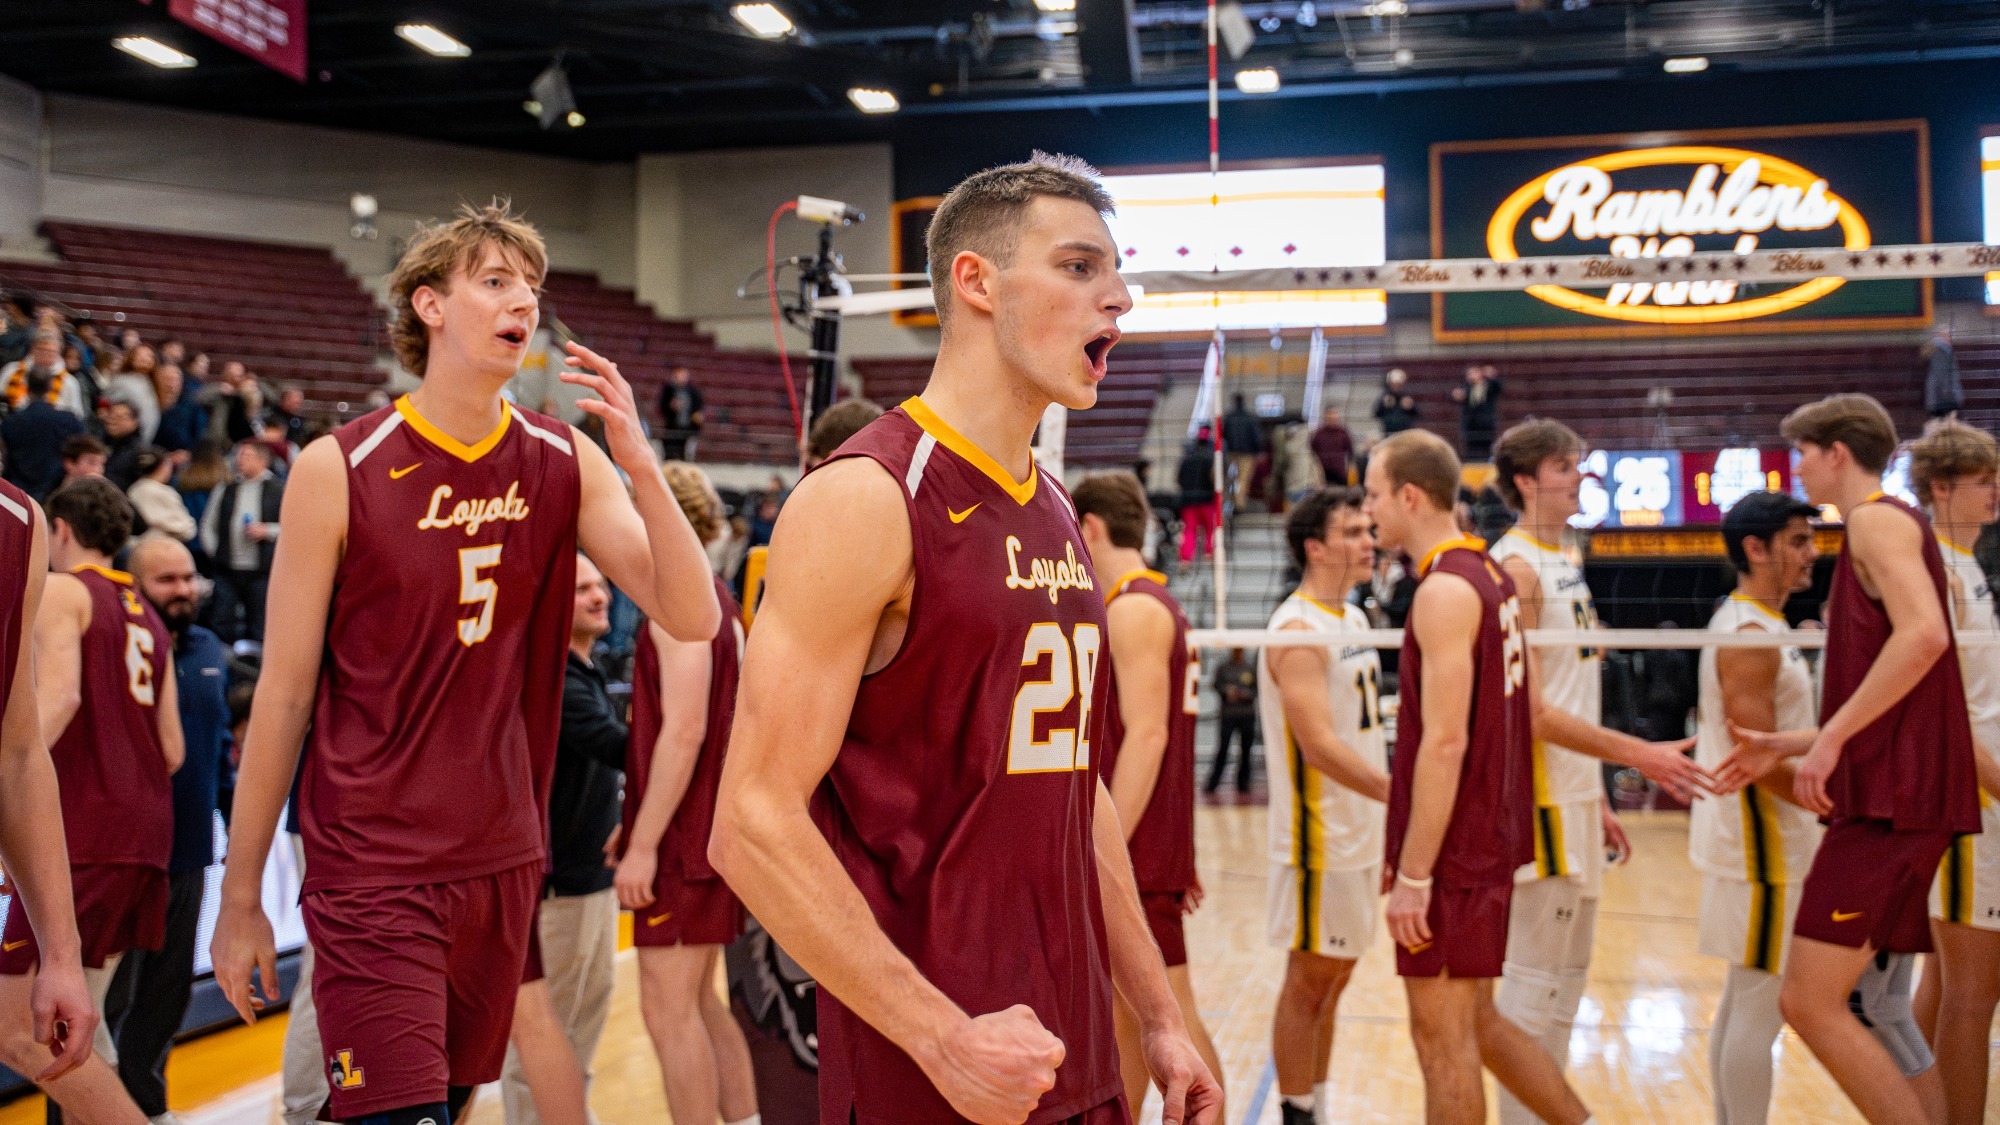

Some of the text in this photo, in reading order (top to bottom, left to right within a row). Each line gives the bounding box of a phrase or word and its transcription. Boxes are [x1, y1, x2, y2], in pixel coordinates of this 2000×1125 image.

[1531, 157, 1841, 242] Ramblers
[417, 480, 530, 536] Loyola
[457, 543, 504, 647] 5
[1005, 535, 1094, 605] Loyola
